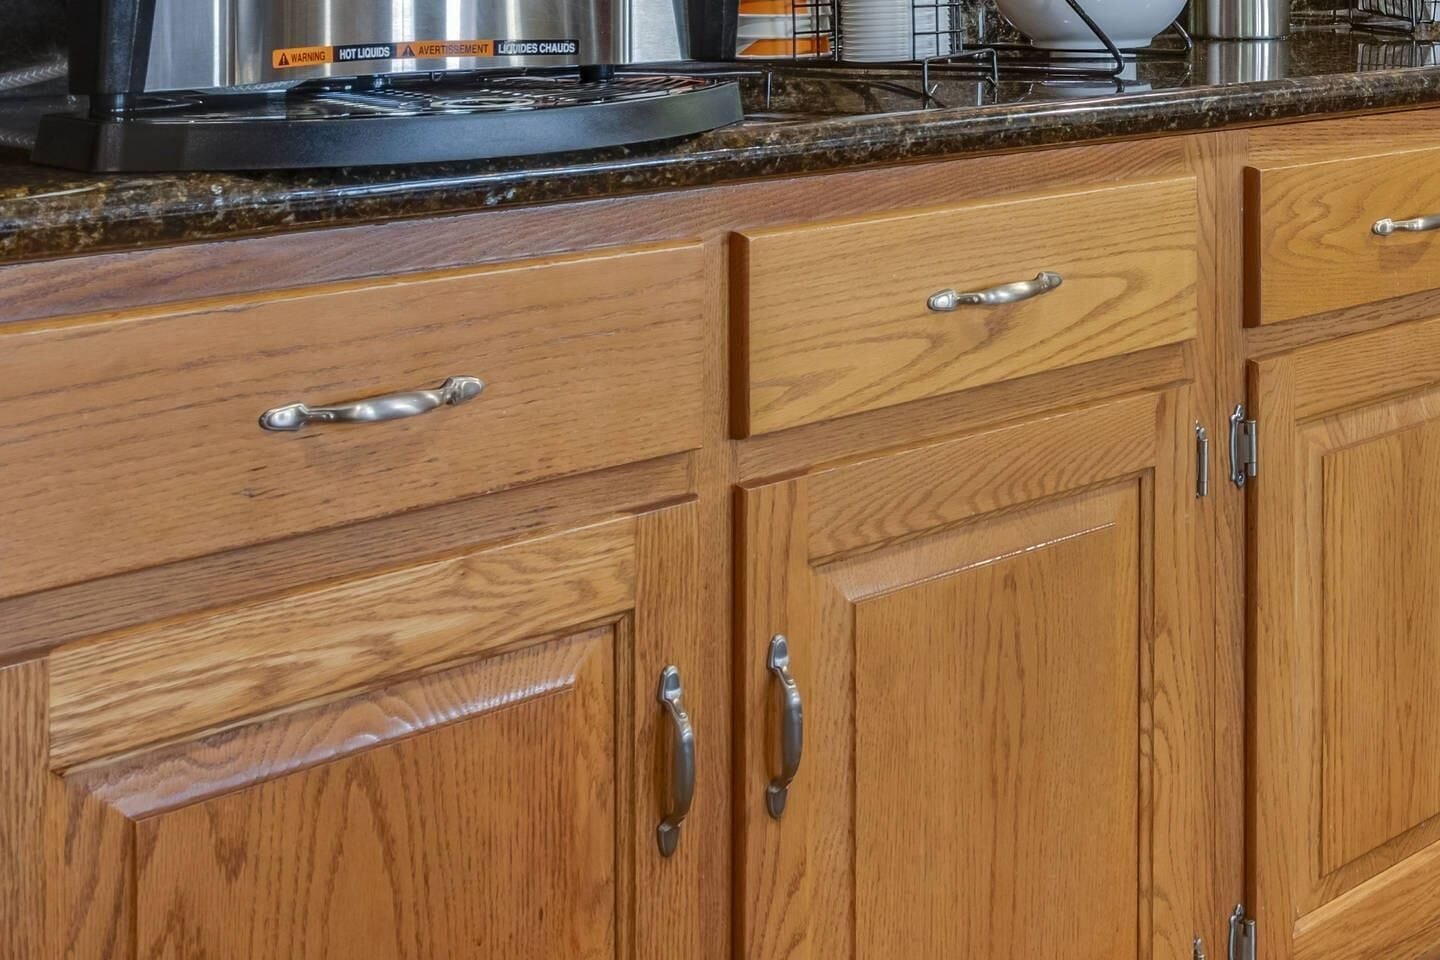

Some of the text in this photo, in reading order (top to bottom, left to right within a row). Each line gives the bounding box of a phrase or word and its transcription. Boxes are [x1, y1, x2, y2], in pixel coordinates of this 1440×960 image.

[290, 42, 576, 63] WARNING HOT LIQUIDS AVERTISSEMENT LIQUIDES CHAUDS
